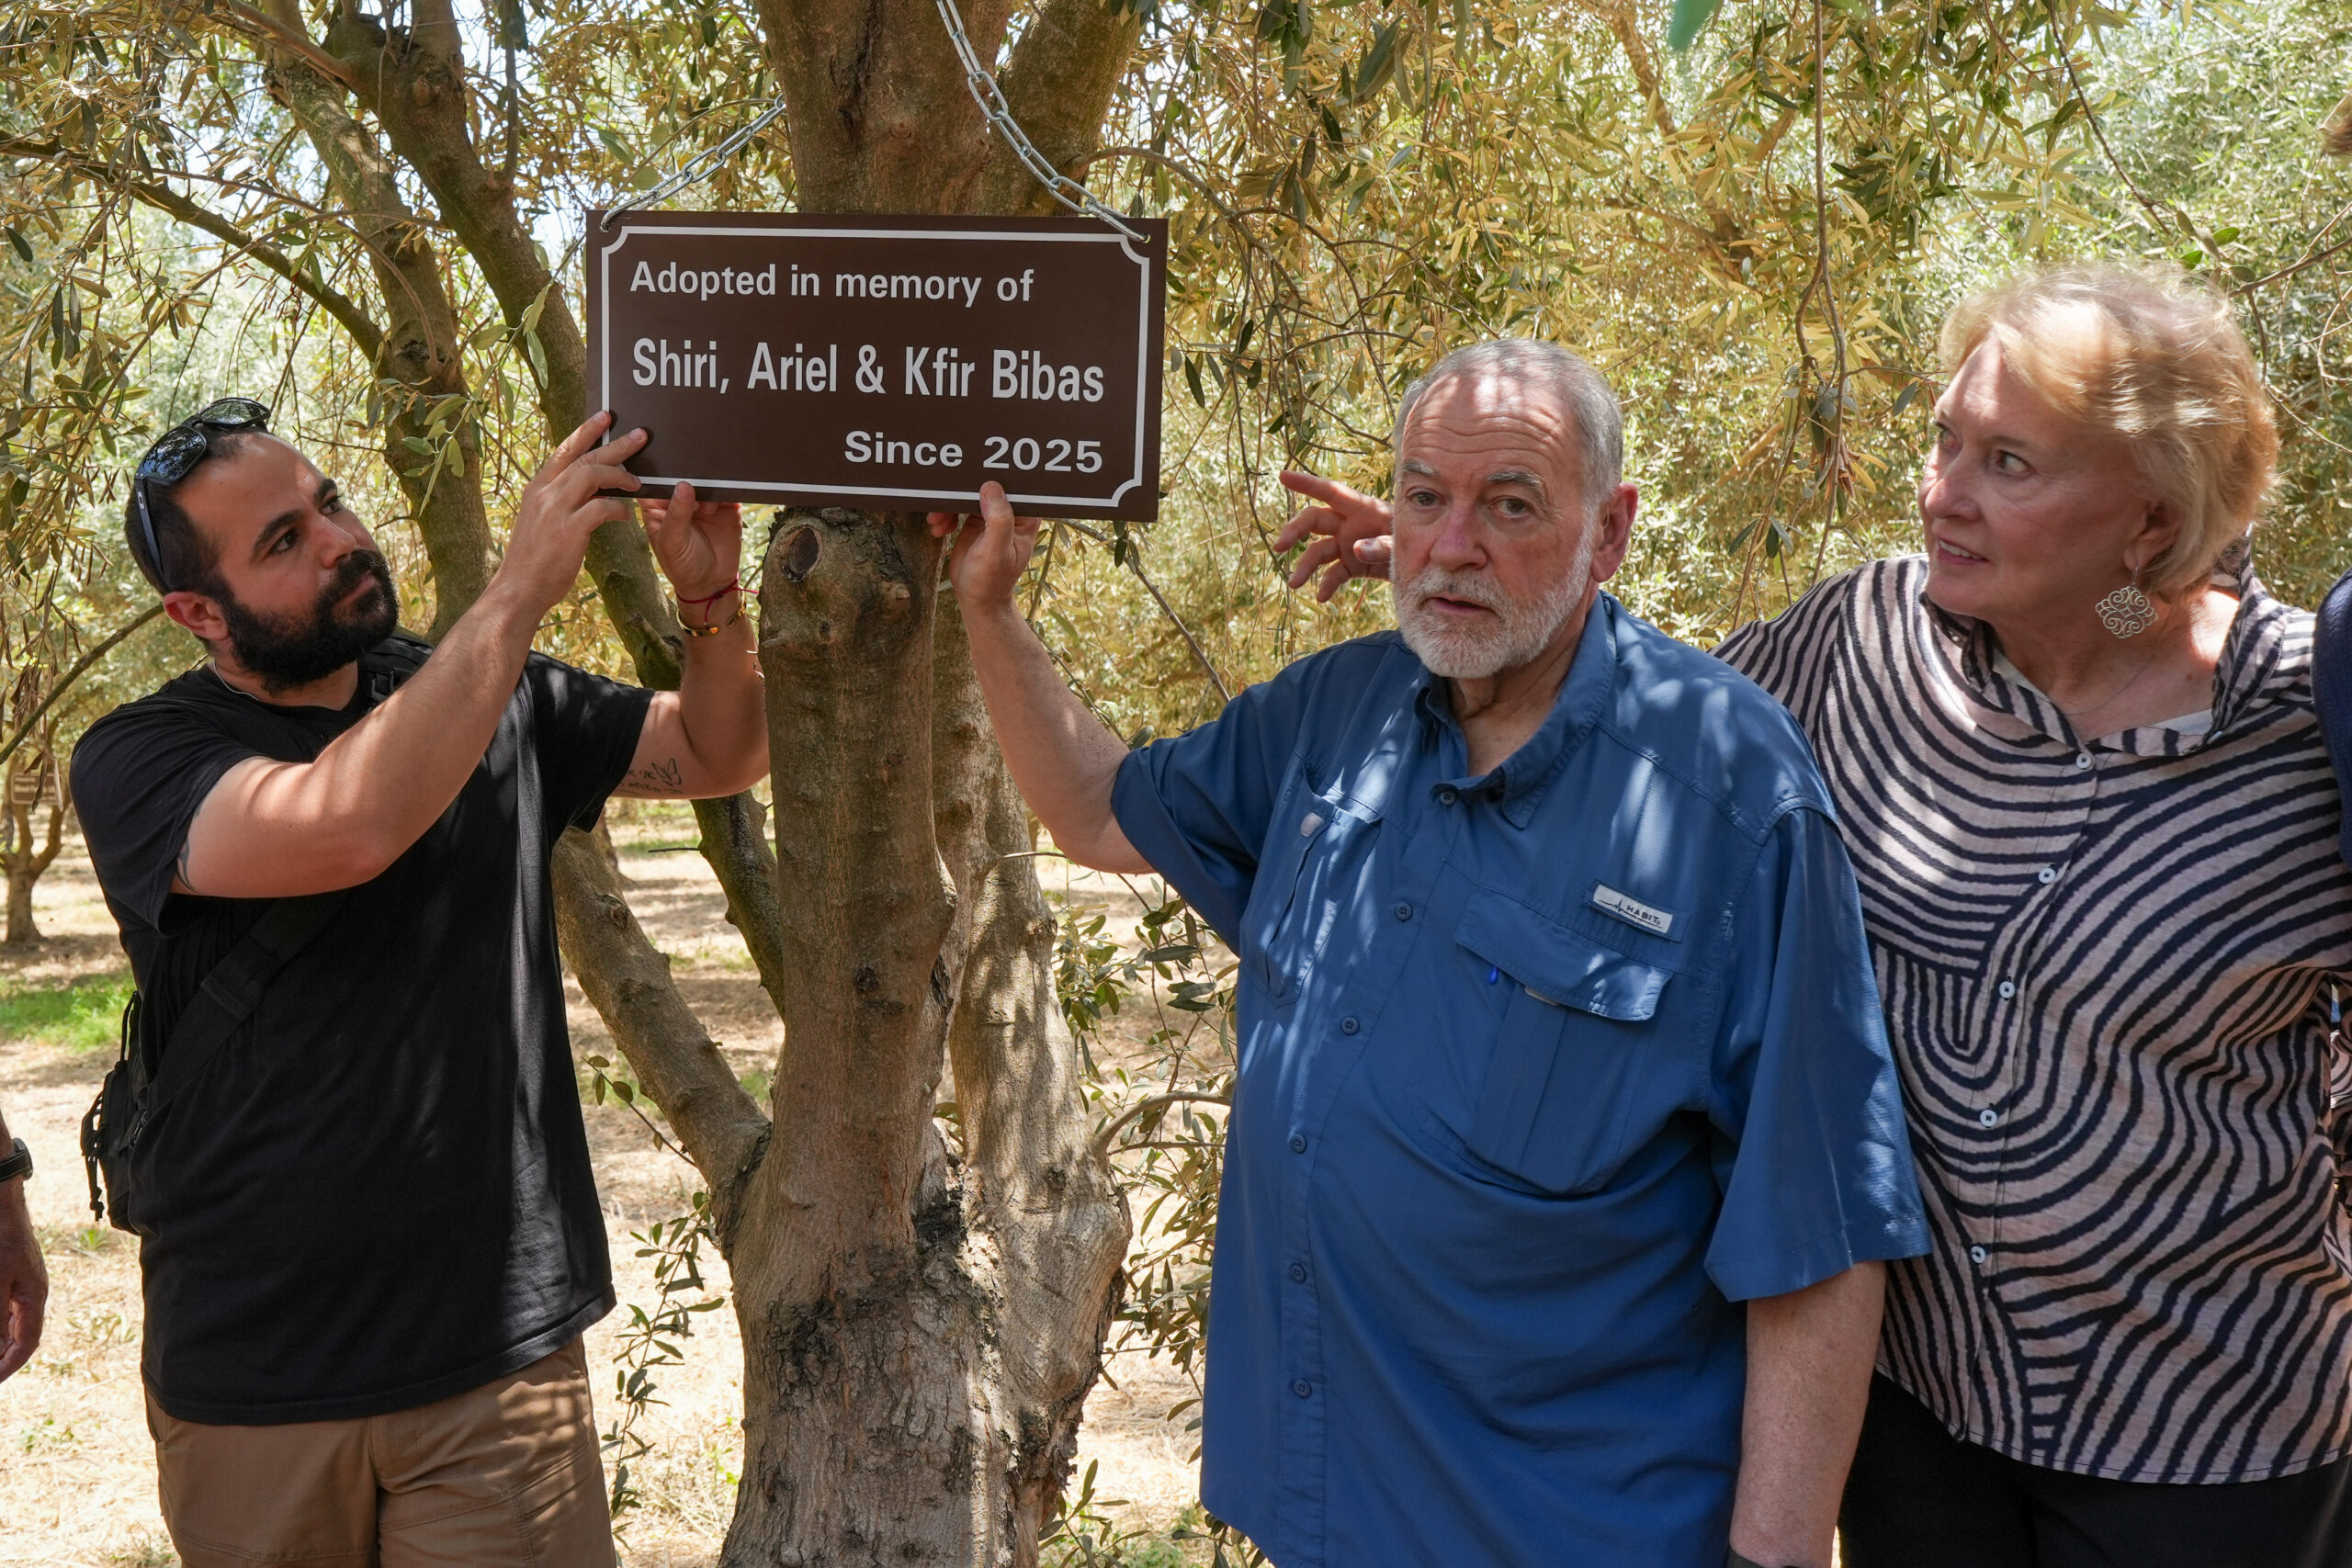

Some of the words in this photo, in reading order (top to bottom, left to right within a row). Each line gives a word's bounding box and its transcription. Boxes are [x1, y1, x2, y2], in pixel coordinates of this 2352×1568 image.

[630, 260, 776, 301] Adopted
[791, 264, 820, 297] in
[835, 274, 982, 308] memory
[997, 268, 1035, 302] of
[632, 337, 729, 394] Shiri,
[747, 342, 837, 392] Ariel
[854, 344, 887, 394] &
[905, 346, 976, 397] Kfir
[992, 349, 1104, 402] Bibas
[844, 430, 963, 468] Since
[982, 436, 1102, 473] 2025
[1626, 905, 1658, 923] HABIT
